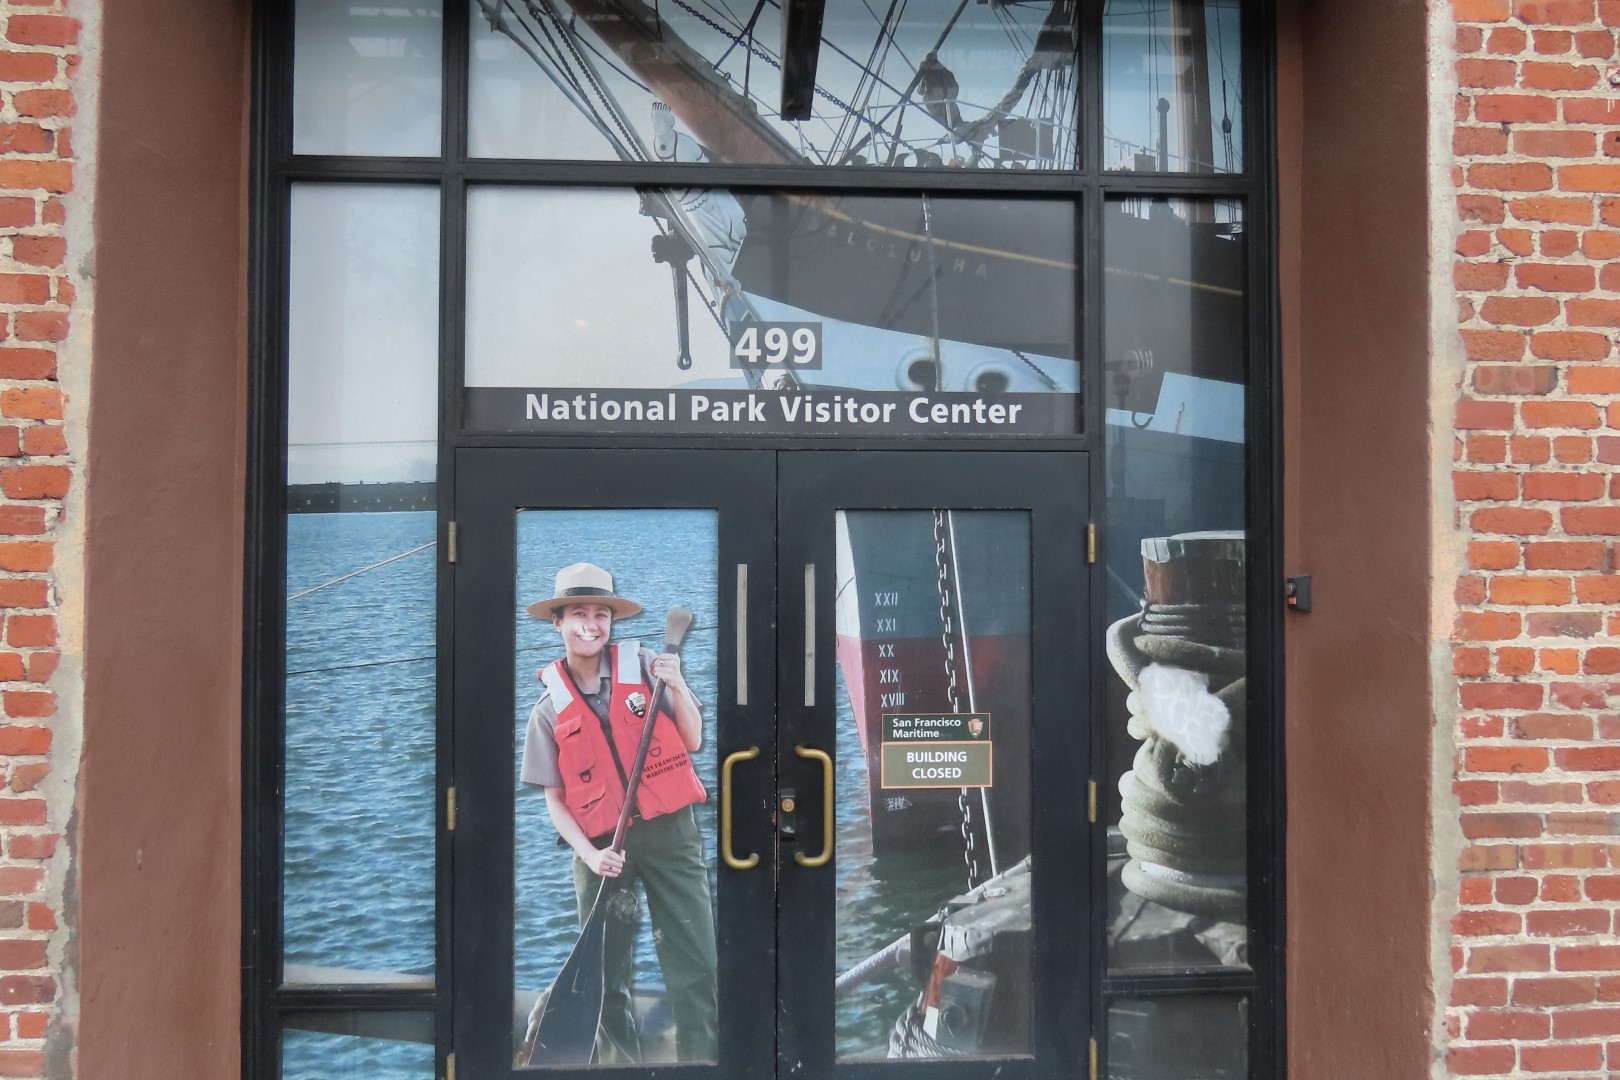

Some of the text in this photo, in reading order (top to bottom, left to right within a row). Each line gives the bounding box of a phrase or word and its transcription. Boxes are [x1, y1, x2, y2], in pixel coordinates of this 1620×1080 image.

[733, 327, 817, 364] 499
[526, 393, 1022, 424] National Park Visitor Center
[875, 592, 898, 606] XXII
[877, 618, 896, 632] XXI
[879, 644, 895, 658] XX
[880, 669, 899, 684] XIX
[881, 692, 905, 708] XVIII
[892, 717, 961, 727] San Francisco
[892, 728, 940, 738] Maritime
[654, 752, 686, 769] FRANCISCO
[906, 751, 967, 763] BUILDING
[646, 764, 674, 779] MARITIME
[912, 767, 962, 780] CLOSED
